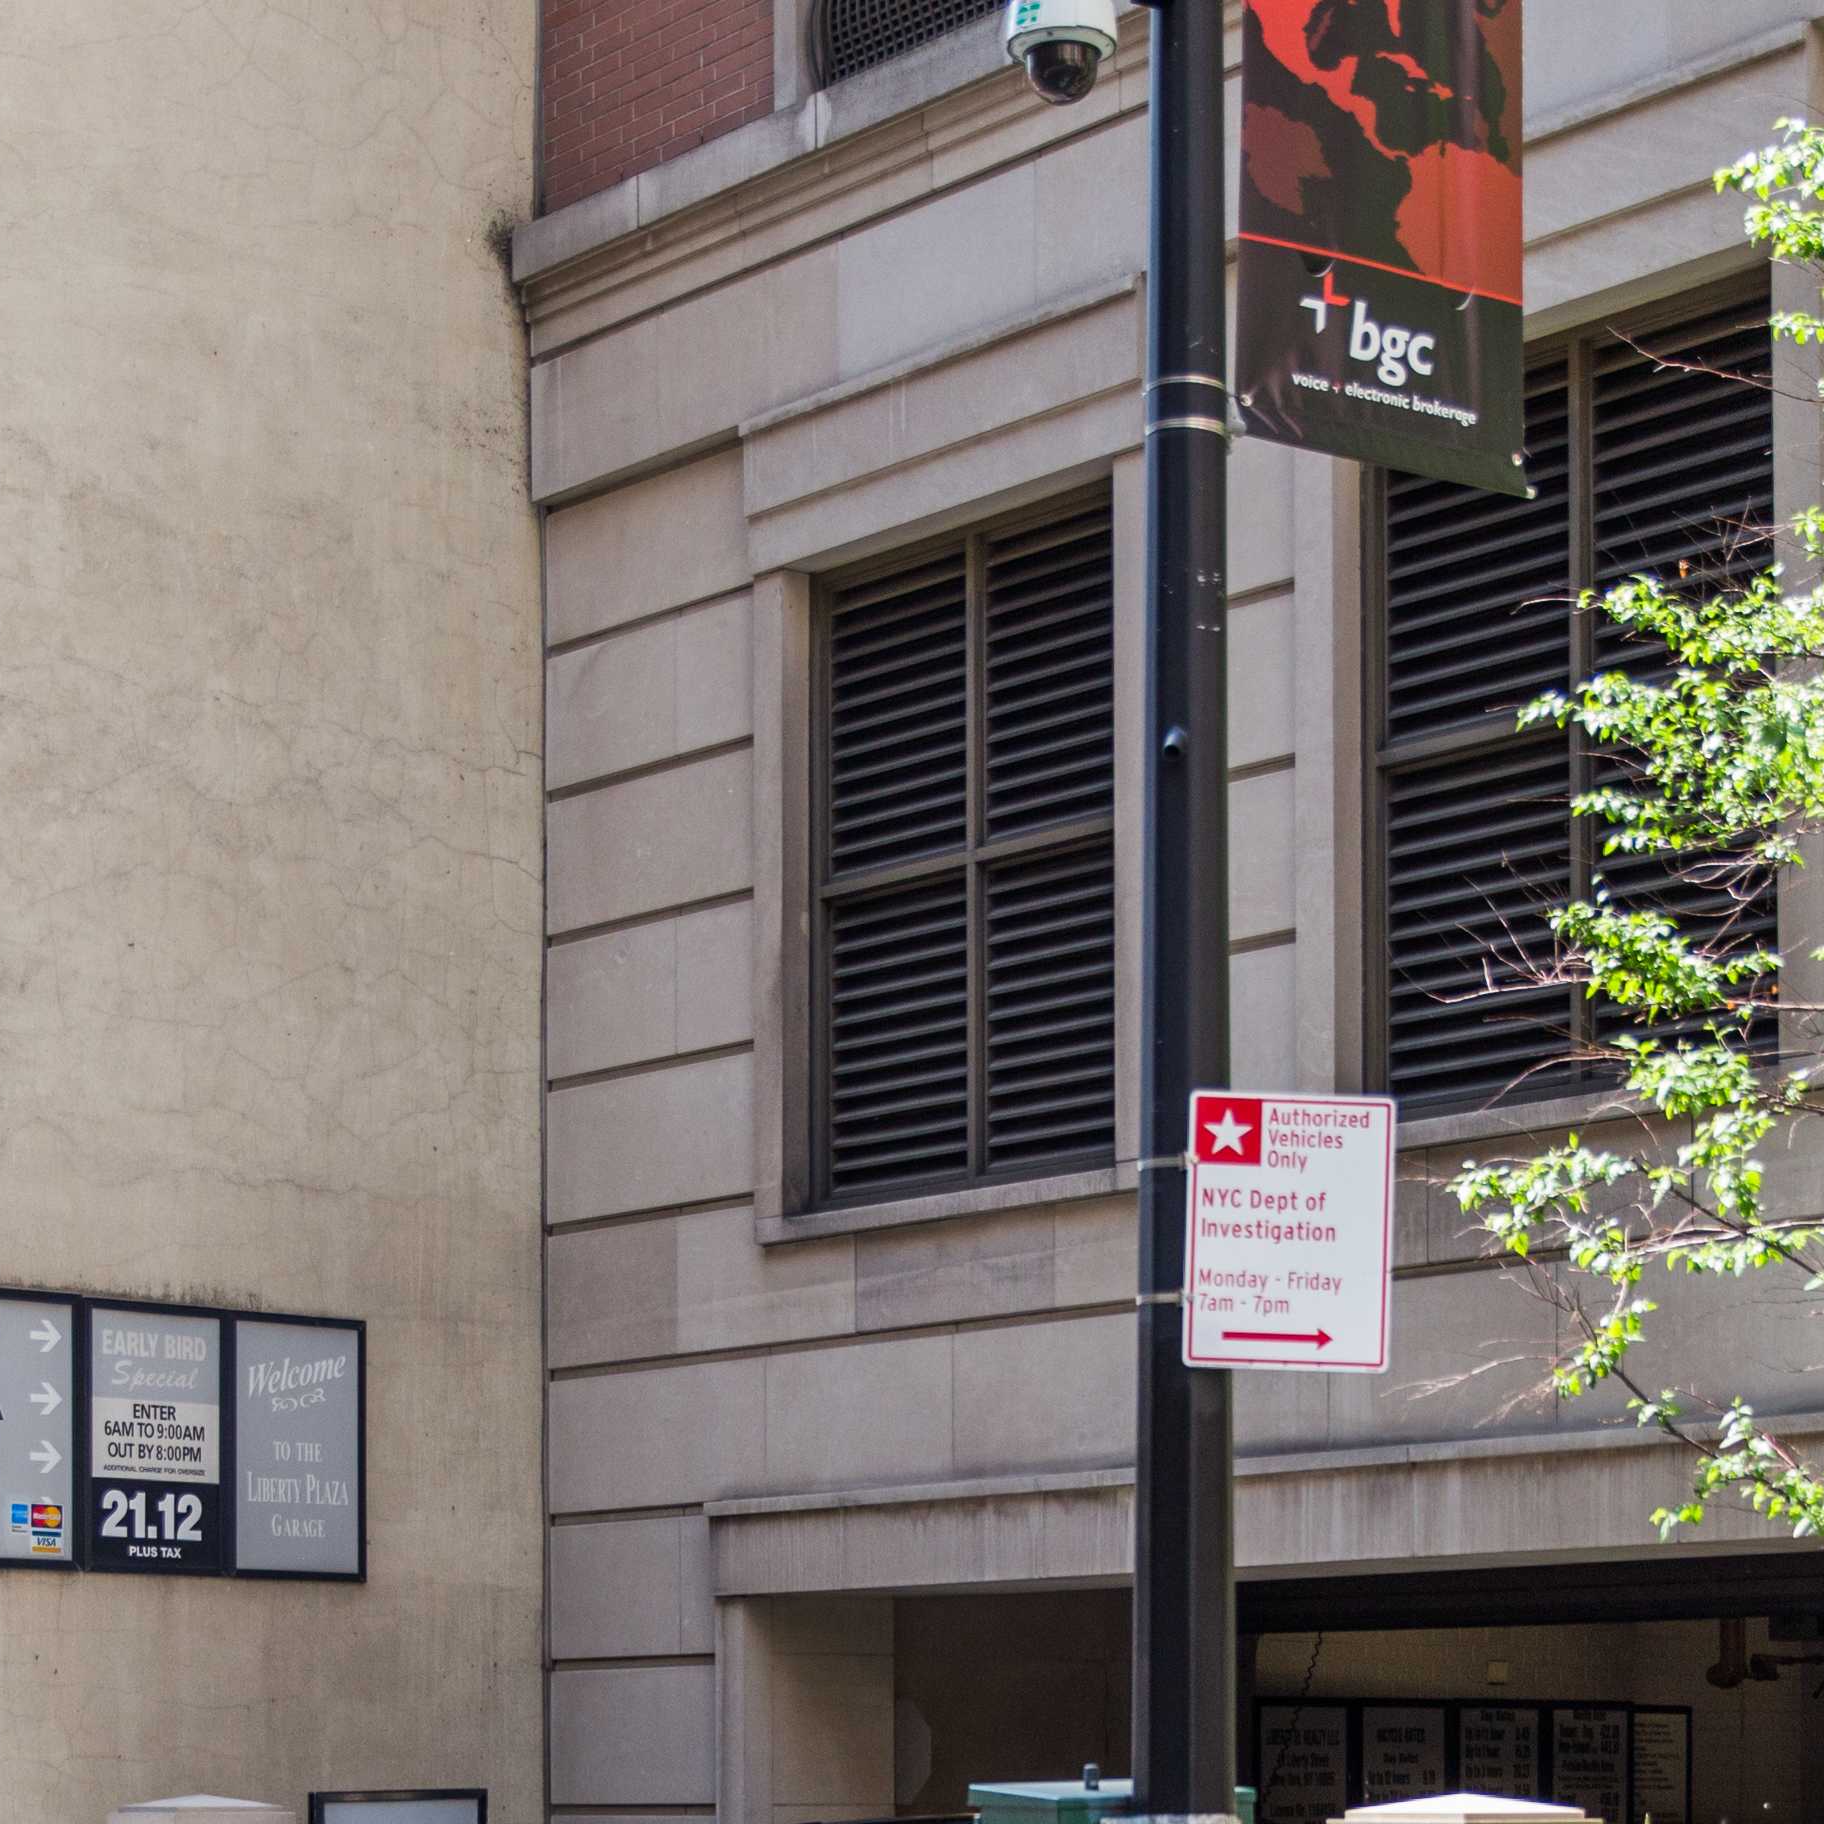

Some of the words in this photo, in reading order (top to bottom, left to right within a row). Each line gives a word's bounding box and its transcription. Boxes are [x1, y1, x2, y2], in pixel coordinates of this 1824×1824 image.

[1349, 300, 1435, 387] bgc
[1292, 373, 1329, 393] voice
[1345, 381, 1410, 410] electronic
[1412, 394, 1477, 427] brokerage
[1268, 1108, 1370, 1129] Authorized
[1268, 1130, 1344, 1149] Vehicles
[1267, 1150, 1308, 1173] Only
[1202, 1188, 1242, 1208] NYC
[1250, 1189, 1298, 1214] Dept
[1306, 1191, 1327, 1211] of
[1201, 1218, 1336, 1244] Investigation
[1199, 1269, 1268, 1292] Monday
[1287, 1271, 1343, 1294] Friday
[1199, 1293, 1234, 1312] 7am
[1254, 1295, 1290, 1316] 7pm
[102, 1328, 159, 1356] EARLY
[164, 1335, 207, 1362] BIRD
[111, 1360, 199, 1392] Special
[248, 1355, 346, 1400] Welcome
[133, 1403, 176, 1422] ENTER
[104, 1421, 134, 1438] 6AM
[137, 1423, 155, 1439] TO
[157, 1423, 205, 1442] 9:00AM
[107, 1442, 135, 1459] OUT
[138, 1444, 155, 1461] BY
[156, 1445, 202, 1463] 8:00PM
[274, 1440, 291, 1462] TO
[295, 1441, 322, 1463] THE
[103, 1463, 138, 1473] ADDITIONAL
[139, 1466, 162, 1474] CHARGE
[164, 1467, 176, 1475] FOR
[101, 1488, 203, 1542] 21.12
[36, 1537, 57, 1547] VISA
[129, 1545, 158, 1558] PLUS
[160, 1546, 182, 1560] TAX
